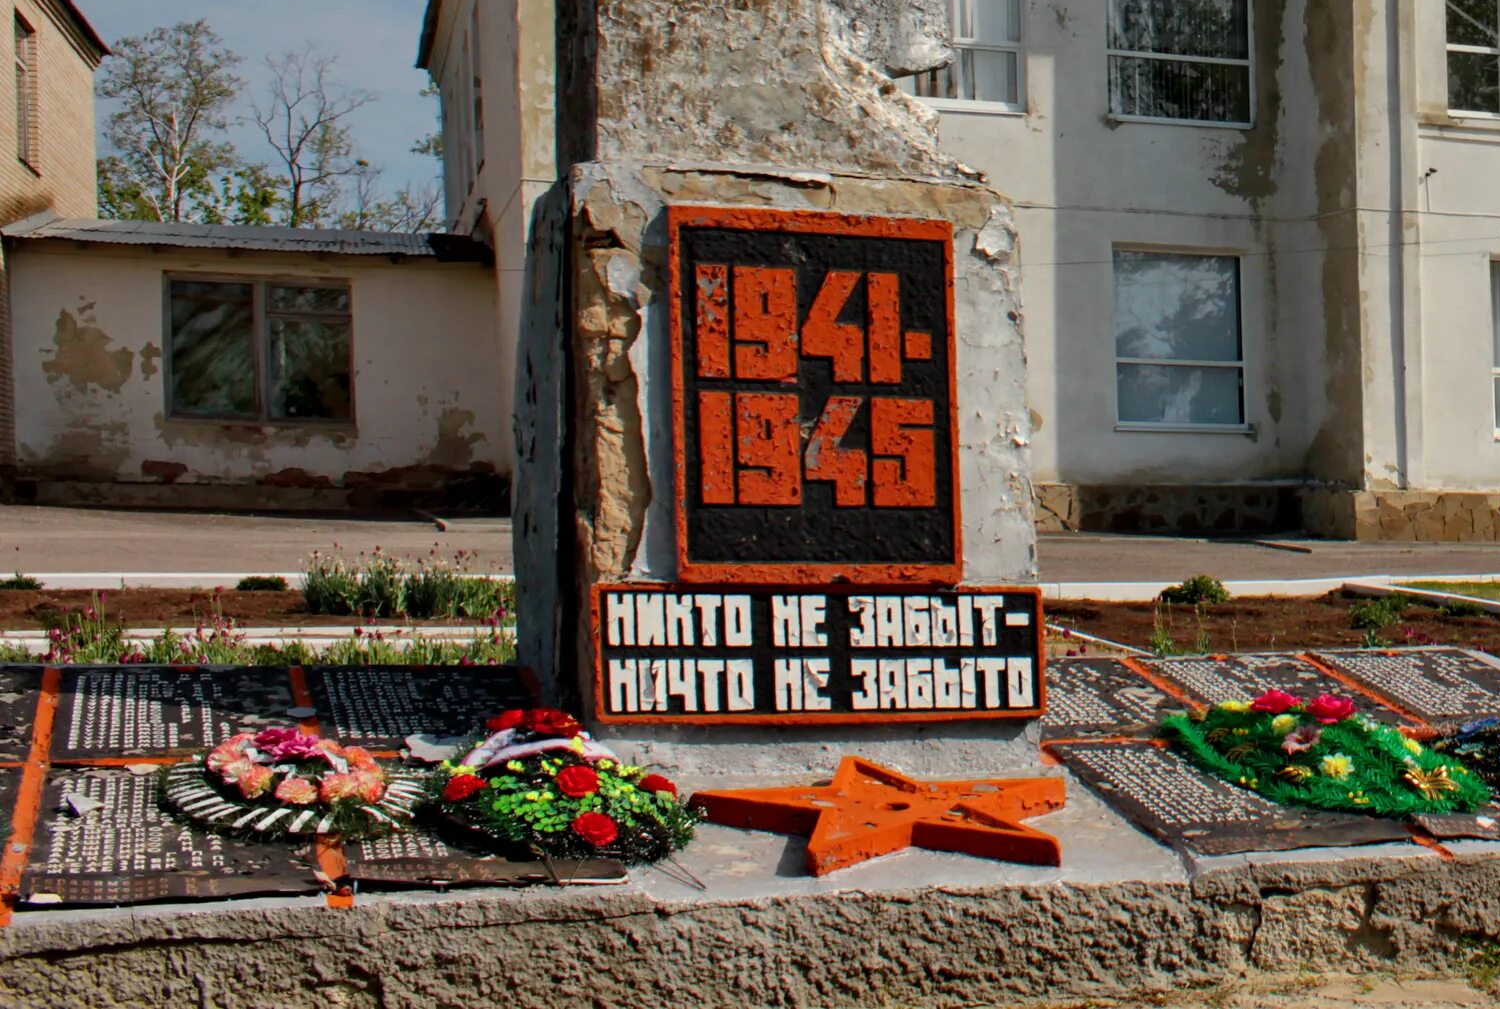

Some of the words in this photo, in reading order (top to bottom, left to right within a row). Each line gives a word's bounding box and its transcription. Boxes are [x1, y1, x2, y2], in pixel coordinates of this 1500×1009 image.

[698, 391, 936, 508] 1945
[606, 593, 753, 648] НИКТО
[771, 594, 827, 648] НЕ
[609, 658, 755, 712] НИЧТО
[774, 657, 832, 712] НЕ
[850, 657, 1034, 711] ЗАБЫТО
